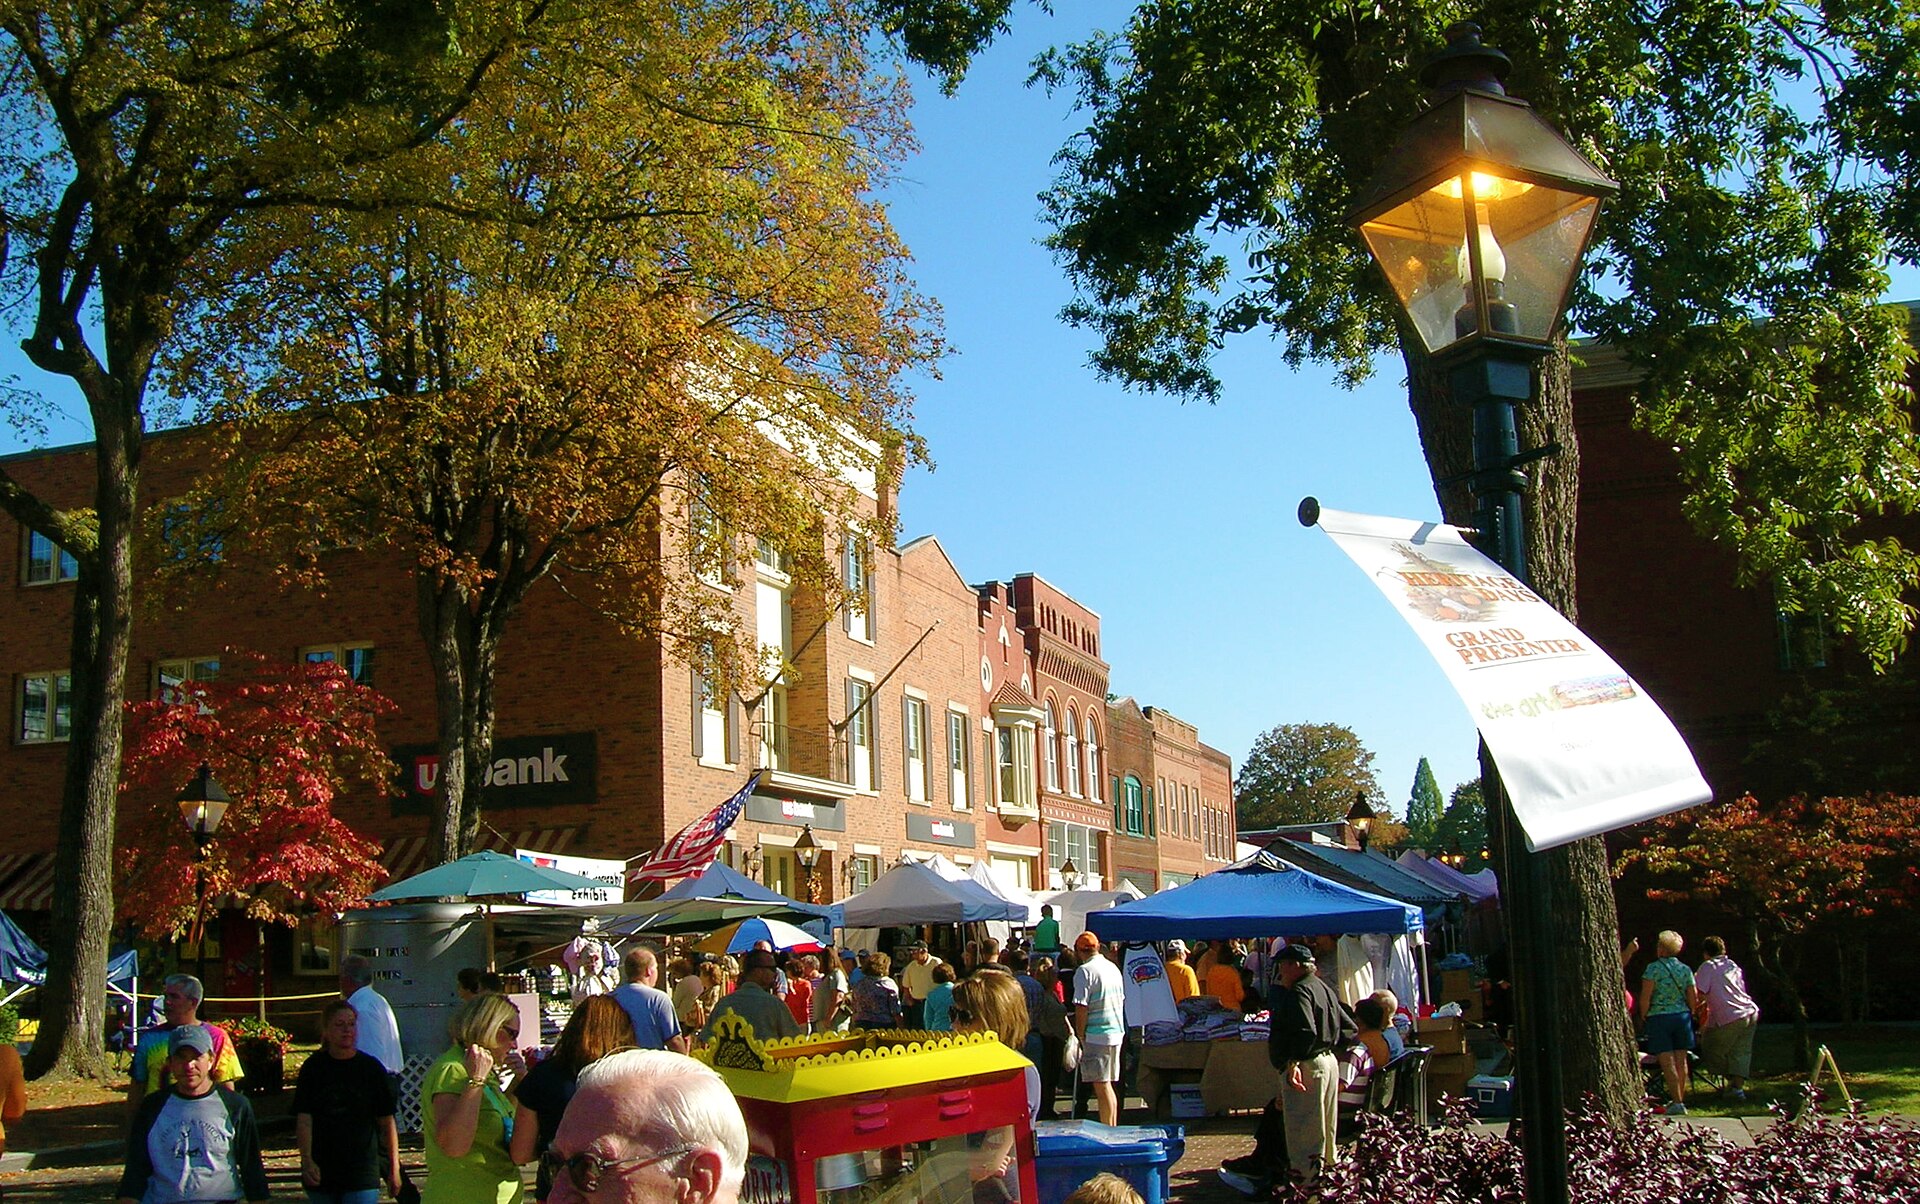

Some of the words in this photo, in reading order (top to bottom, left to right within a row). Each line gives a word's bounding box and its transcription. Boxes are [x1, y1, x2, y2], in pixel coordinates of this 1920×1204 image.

[1397, 571, 1525, 589] HERITAGE
[1475, 587, 1541, 603] DAYS
[1445, 627, 1525, 648] GRAND
[1456, 639, 1586, 665] PRESENTER
[1481, 701, 1514, 720] the
[571, 887, 608, 902] exhibit
